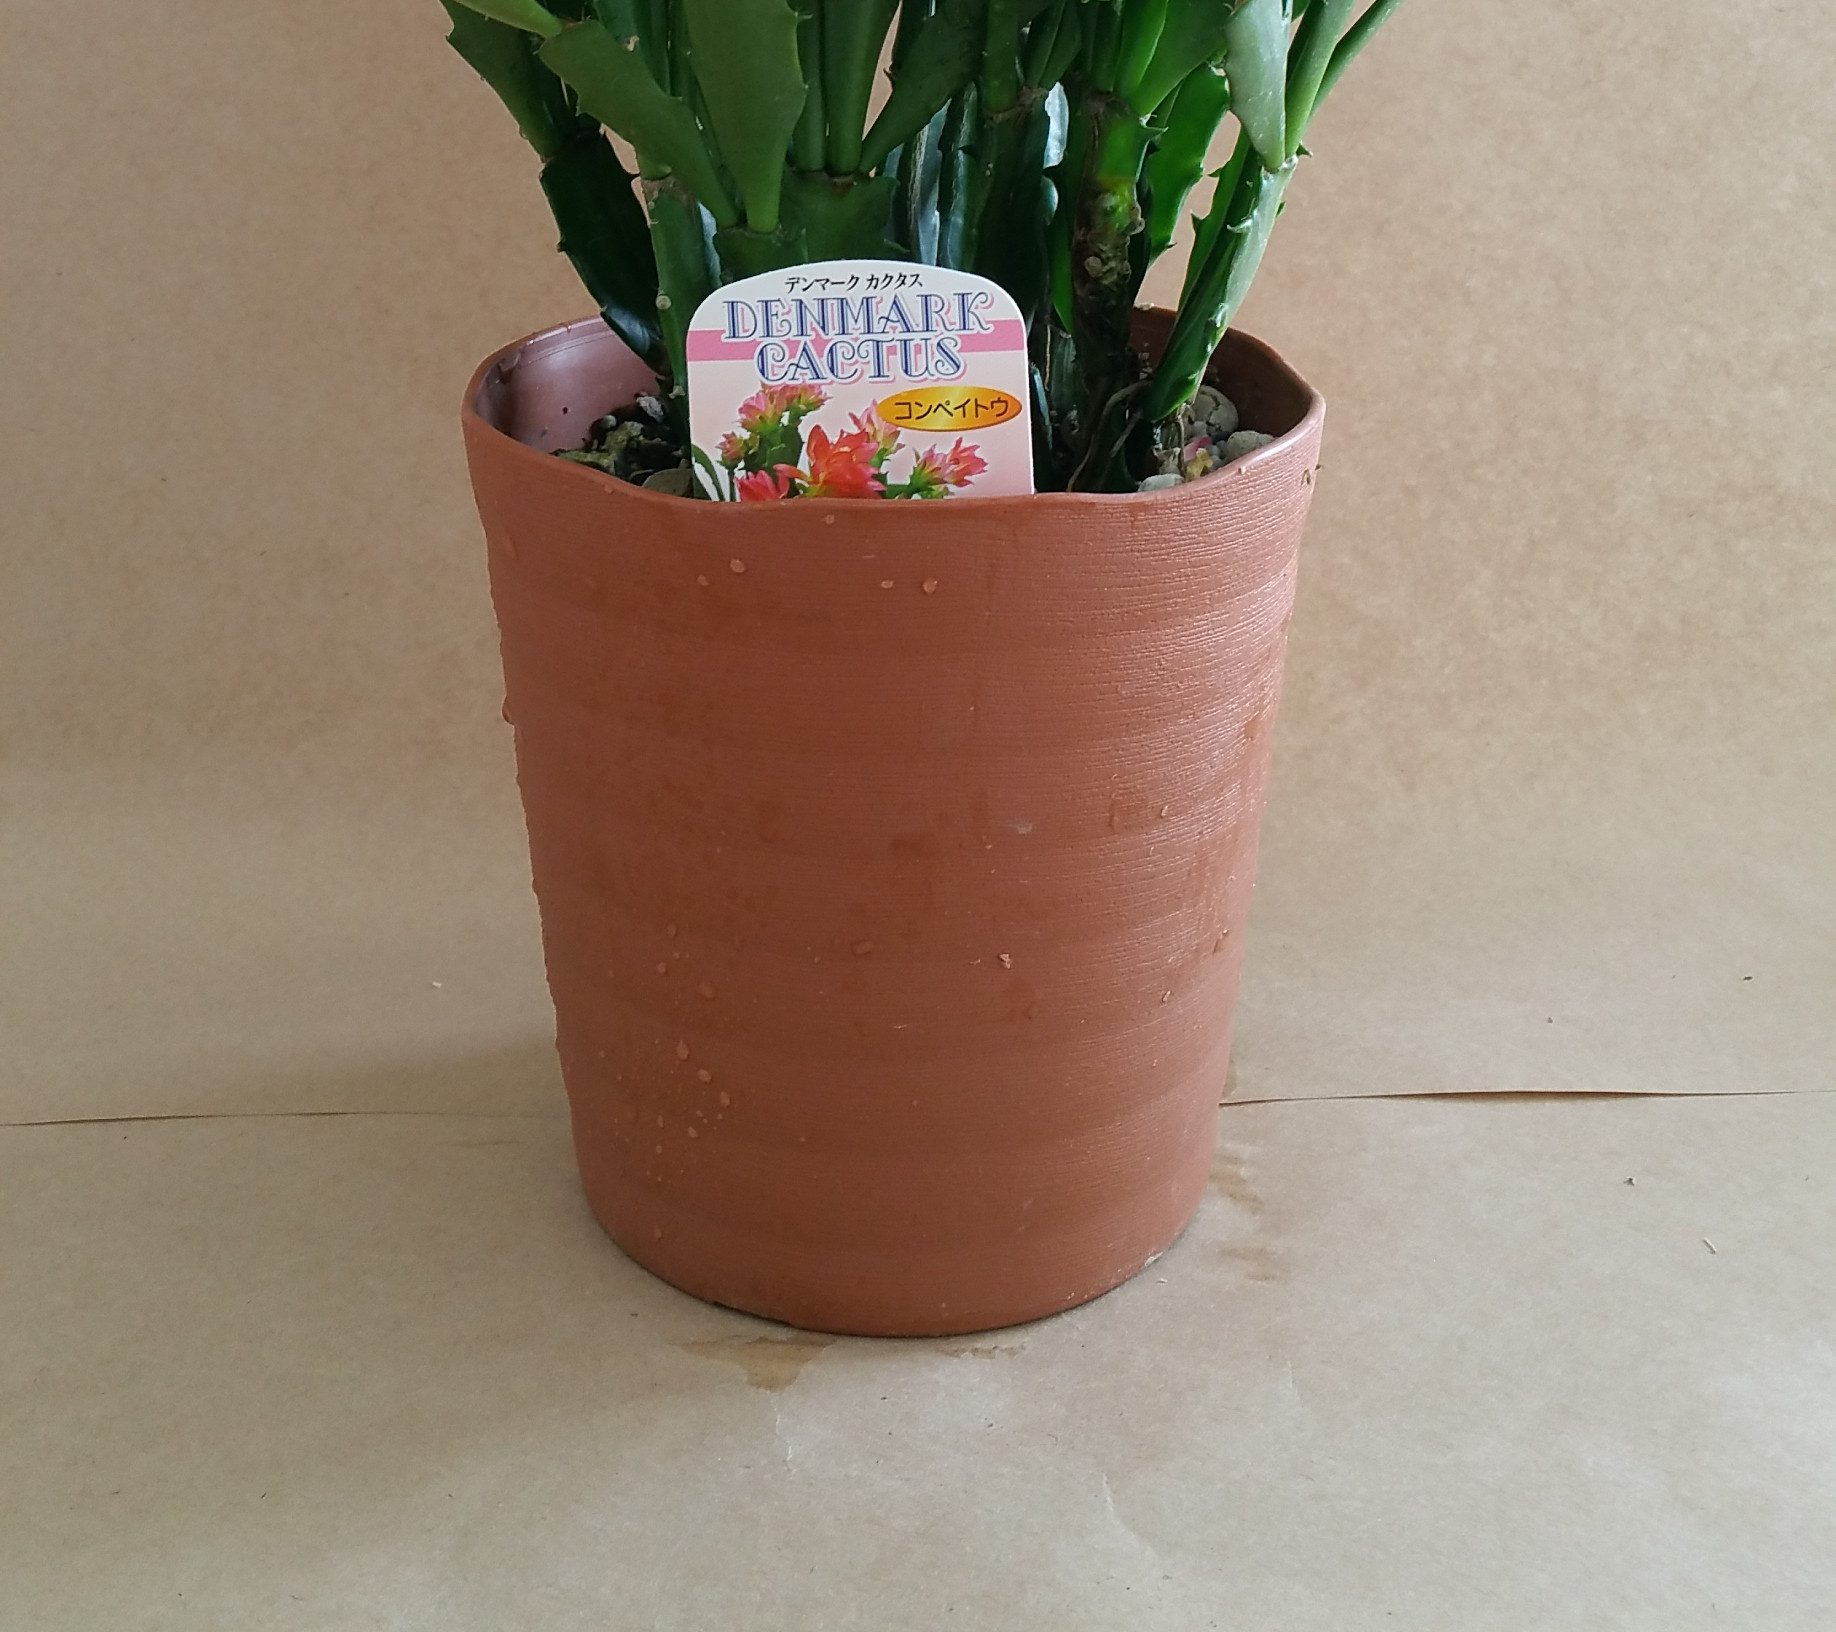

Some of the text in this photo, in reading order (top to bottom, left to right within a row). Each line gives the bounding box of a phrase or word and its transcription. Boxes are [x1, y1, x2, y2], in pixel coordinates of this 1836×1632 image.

[785, 272, 924, 294] デンマーク カクタス
[722, 292, 992, 340] DENMARK
[757, 336, 963, 382] CACTUS
[893, 396, 1009, 420] コンペイトウ
